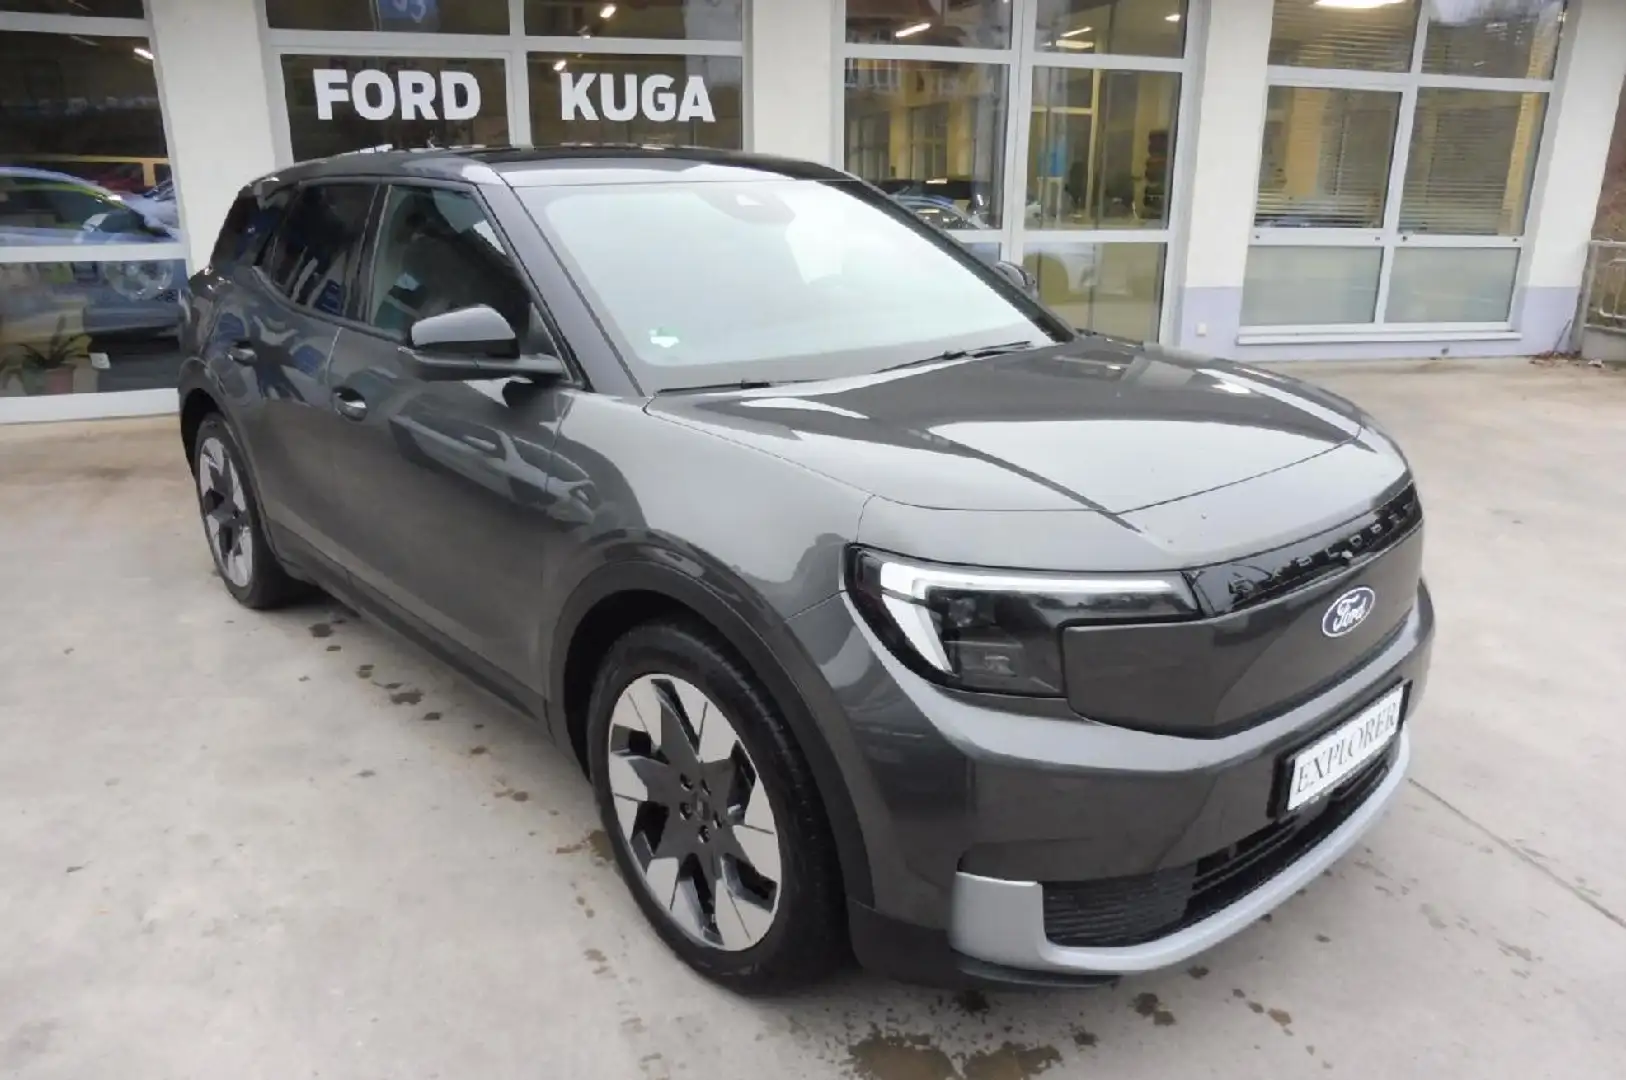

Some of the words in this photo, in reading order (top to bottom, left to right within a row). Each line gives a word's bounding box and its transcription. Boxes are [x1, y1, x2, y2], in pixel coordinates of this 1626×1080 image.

[312, 69, 481, 121] FORD
[560, 72, 716, 123] KUGA
[1328, 591, 1370, 634] Ford
[1296, 702, 1398, 793] EXPLORER
